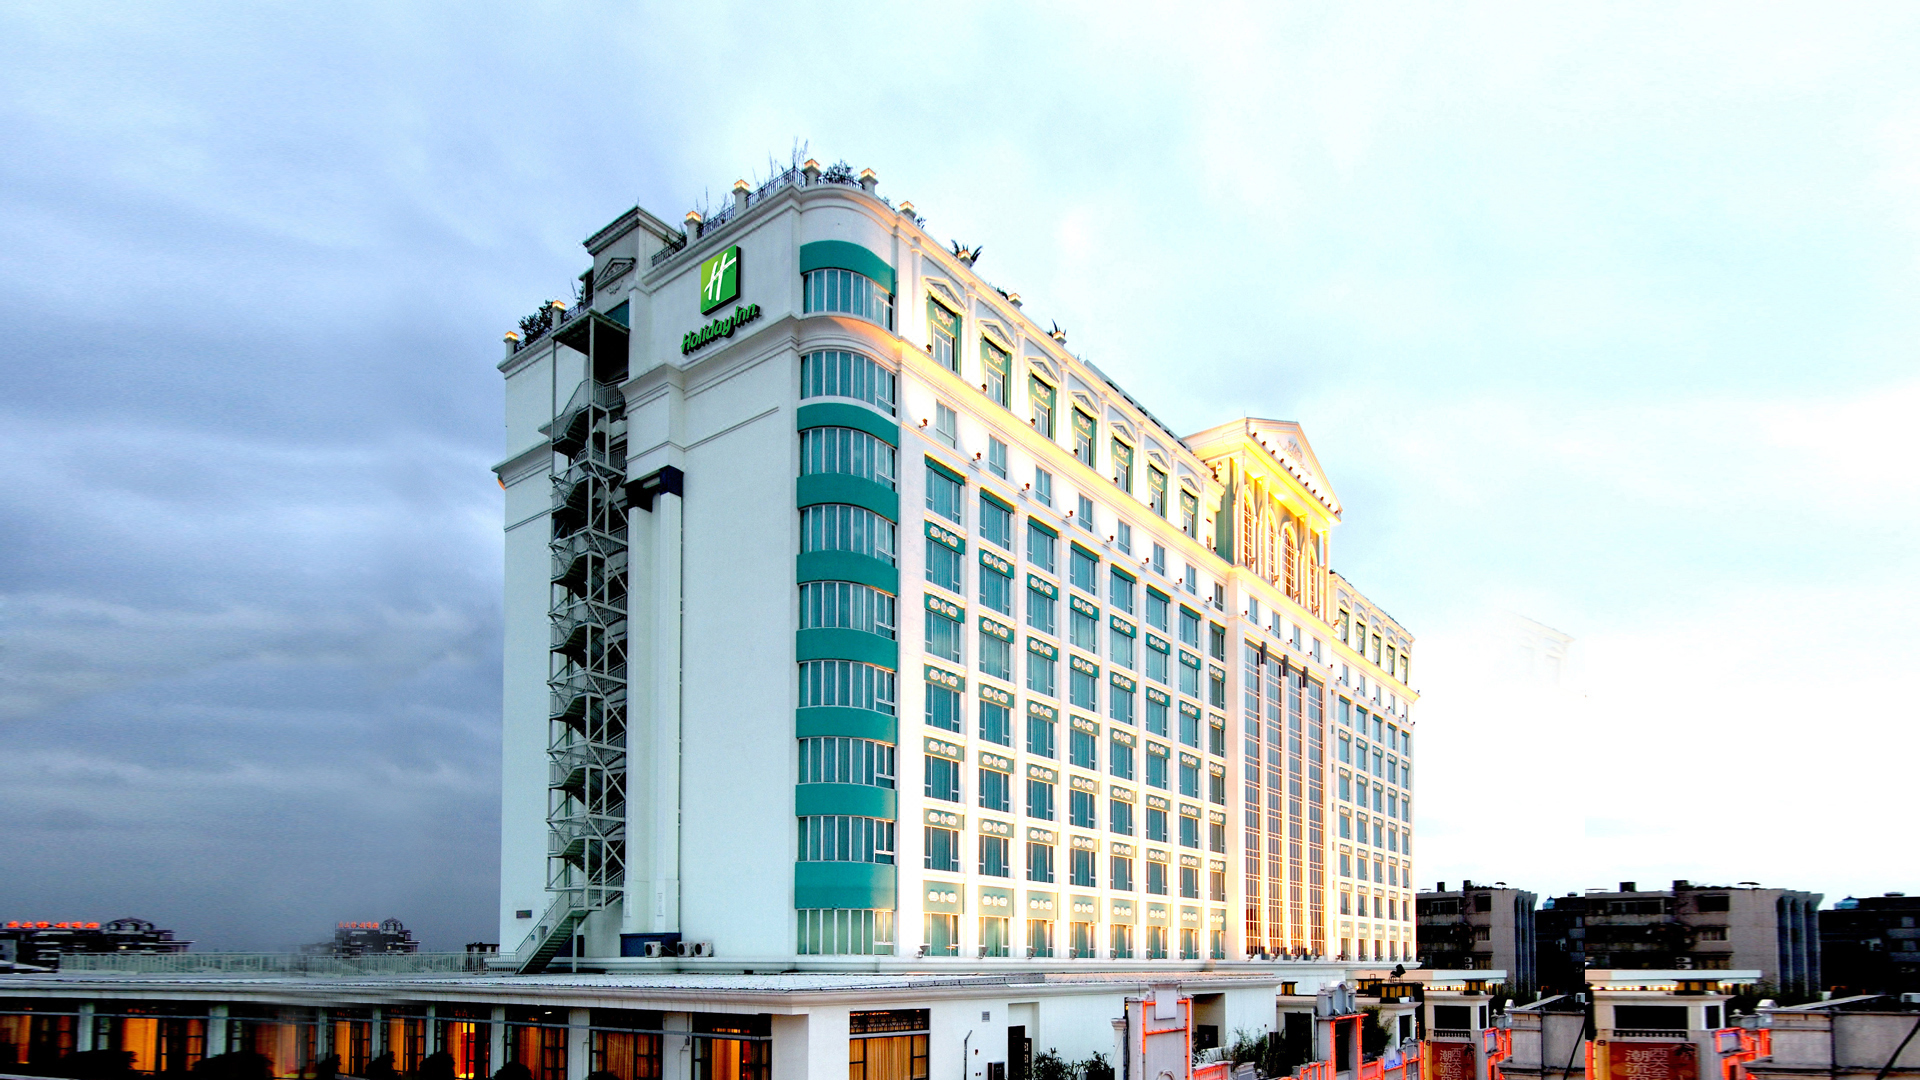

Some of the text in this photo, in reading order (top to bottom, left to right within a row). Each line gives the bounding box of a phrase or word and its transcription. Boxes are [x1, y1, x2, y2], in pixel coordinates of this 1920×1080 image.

[681, 302, 758, 354] Holiday Inn
[1451, 1047, 1462, 1078] 西关至
[1648, 1047, 1669, 1078] 西关至
